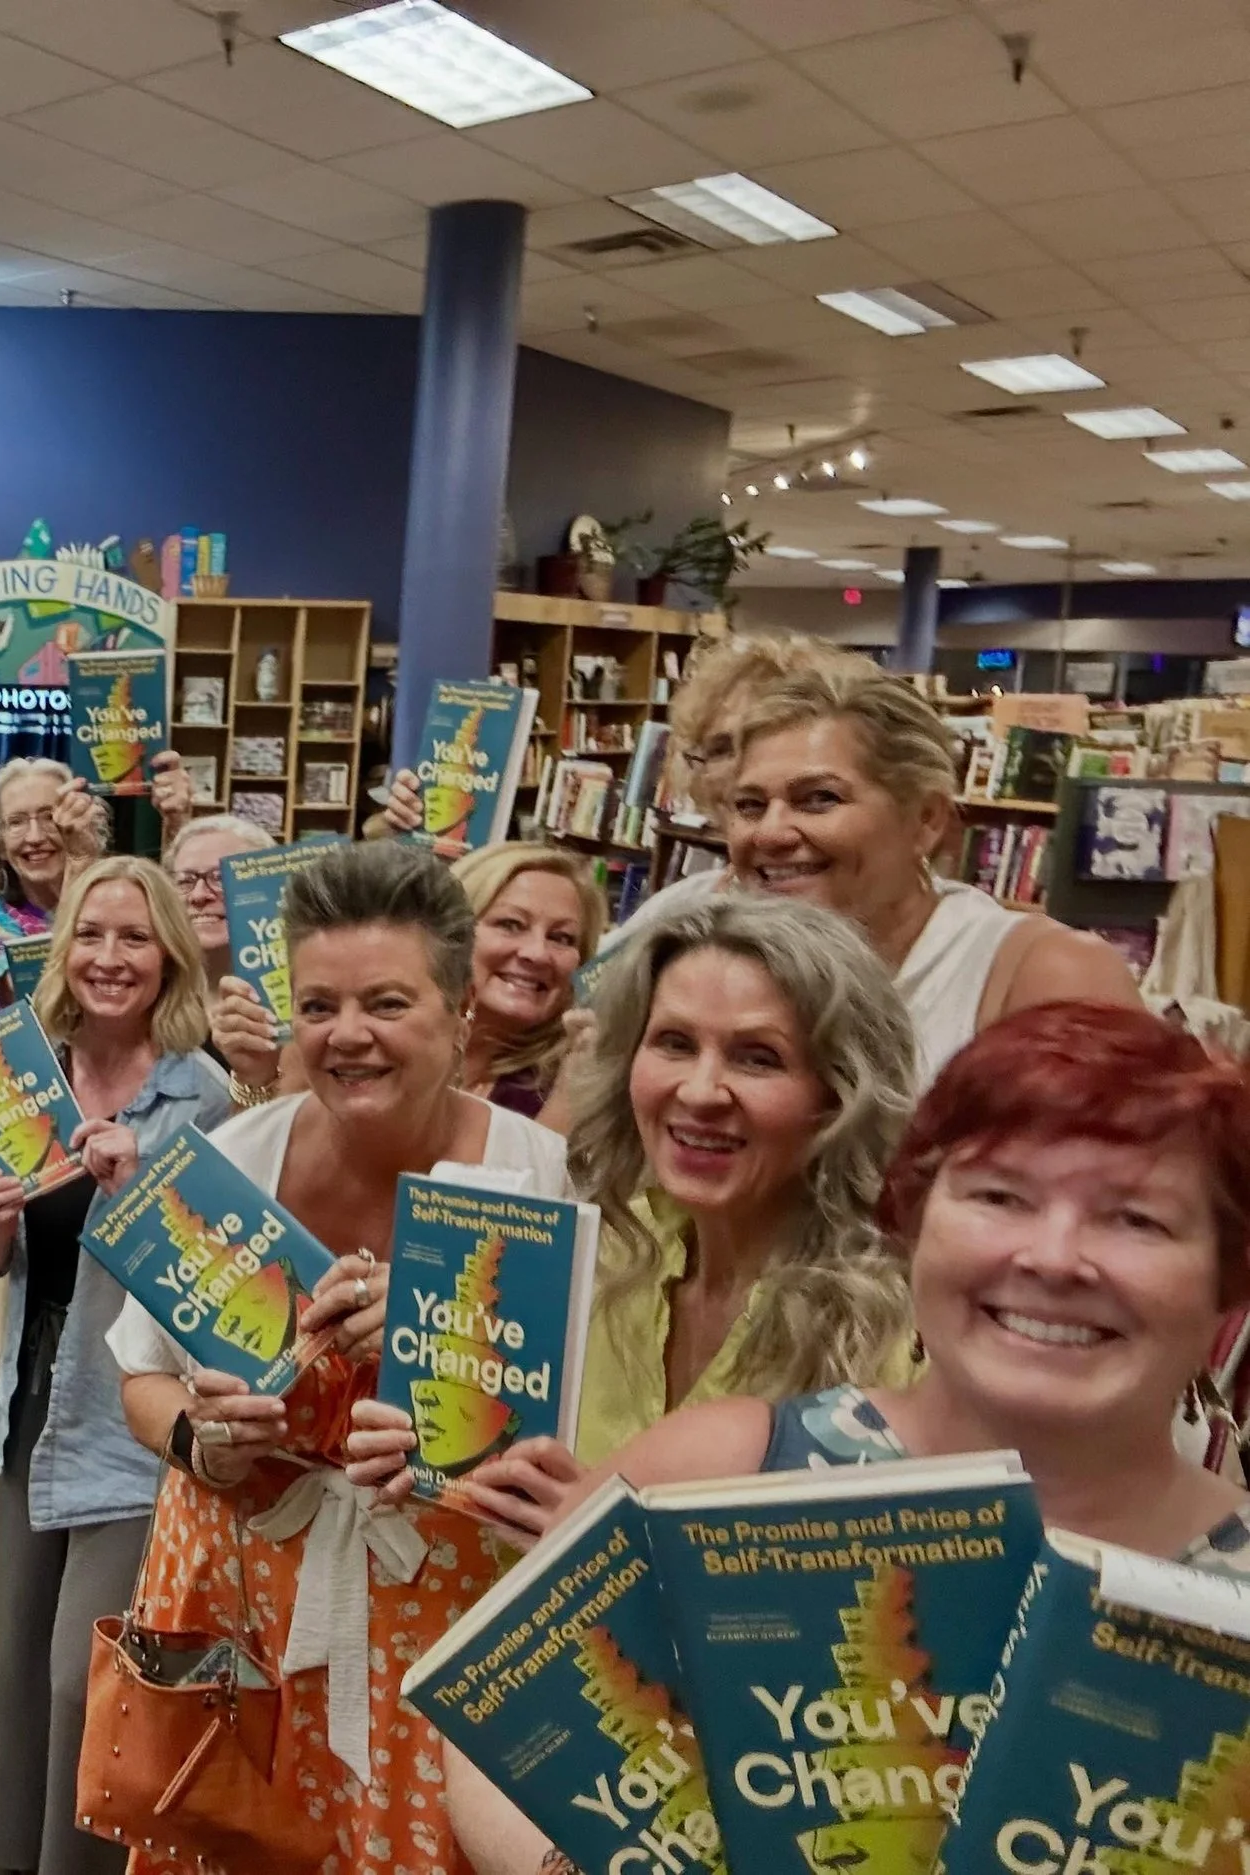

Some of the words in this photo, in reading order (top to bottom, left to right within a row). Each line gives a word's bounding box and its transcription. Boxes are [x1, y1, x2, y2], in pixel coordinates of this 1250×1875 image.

[74, 569, 160, 625] HANDS
[76, 721, 162, 743] Changed
[85, 705, 147, 723] You've
[408, 1185, 430, 1203] The
[430, 1189, 479, 1211] Promise
[481, 1201, 505, 1217] and
[507, 1202, 543, 1225] Price
[544, 1210, 560, 1227] of
[412, 1203, 553, 1245] Self-Transformation
[154, 1212, 243, 1295] You've
[172, 1209, 286, 1333] Changed
[412, 1287, 525, 1350] You've
[391, 1326, 551, 1401] Changed
[406, 1464, 434, 1484] enoit
[681, 1522, 730, 1547] The
[734, 1516, 839, 1544] Promise
[845, 1510, 894, 1538] and
[898, 1506, 972, 1534] Price
[977, 1499, 1006, 1525] of
[703, 1533, 1006, 1576] Self-Transformation
[433, 1679, 470, 1707] The
[463, 1622, 534, 1684] Promise
[532, 1587, 566, 1626] and
[558, 1551, 610, 1597] Price
[608, 1526, 630, 1556] of
[462, 1557, 650, 1724] Self-Transformation
[570, 1718, 696, 1831] You'
[734, 1750, 967, 1816] Chang
[1069, 1763, 1250, 1867] You'
